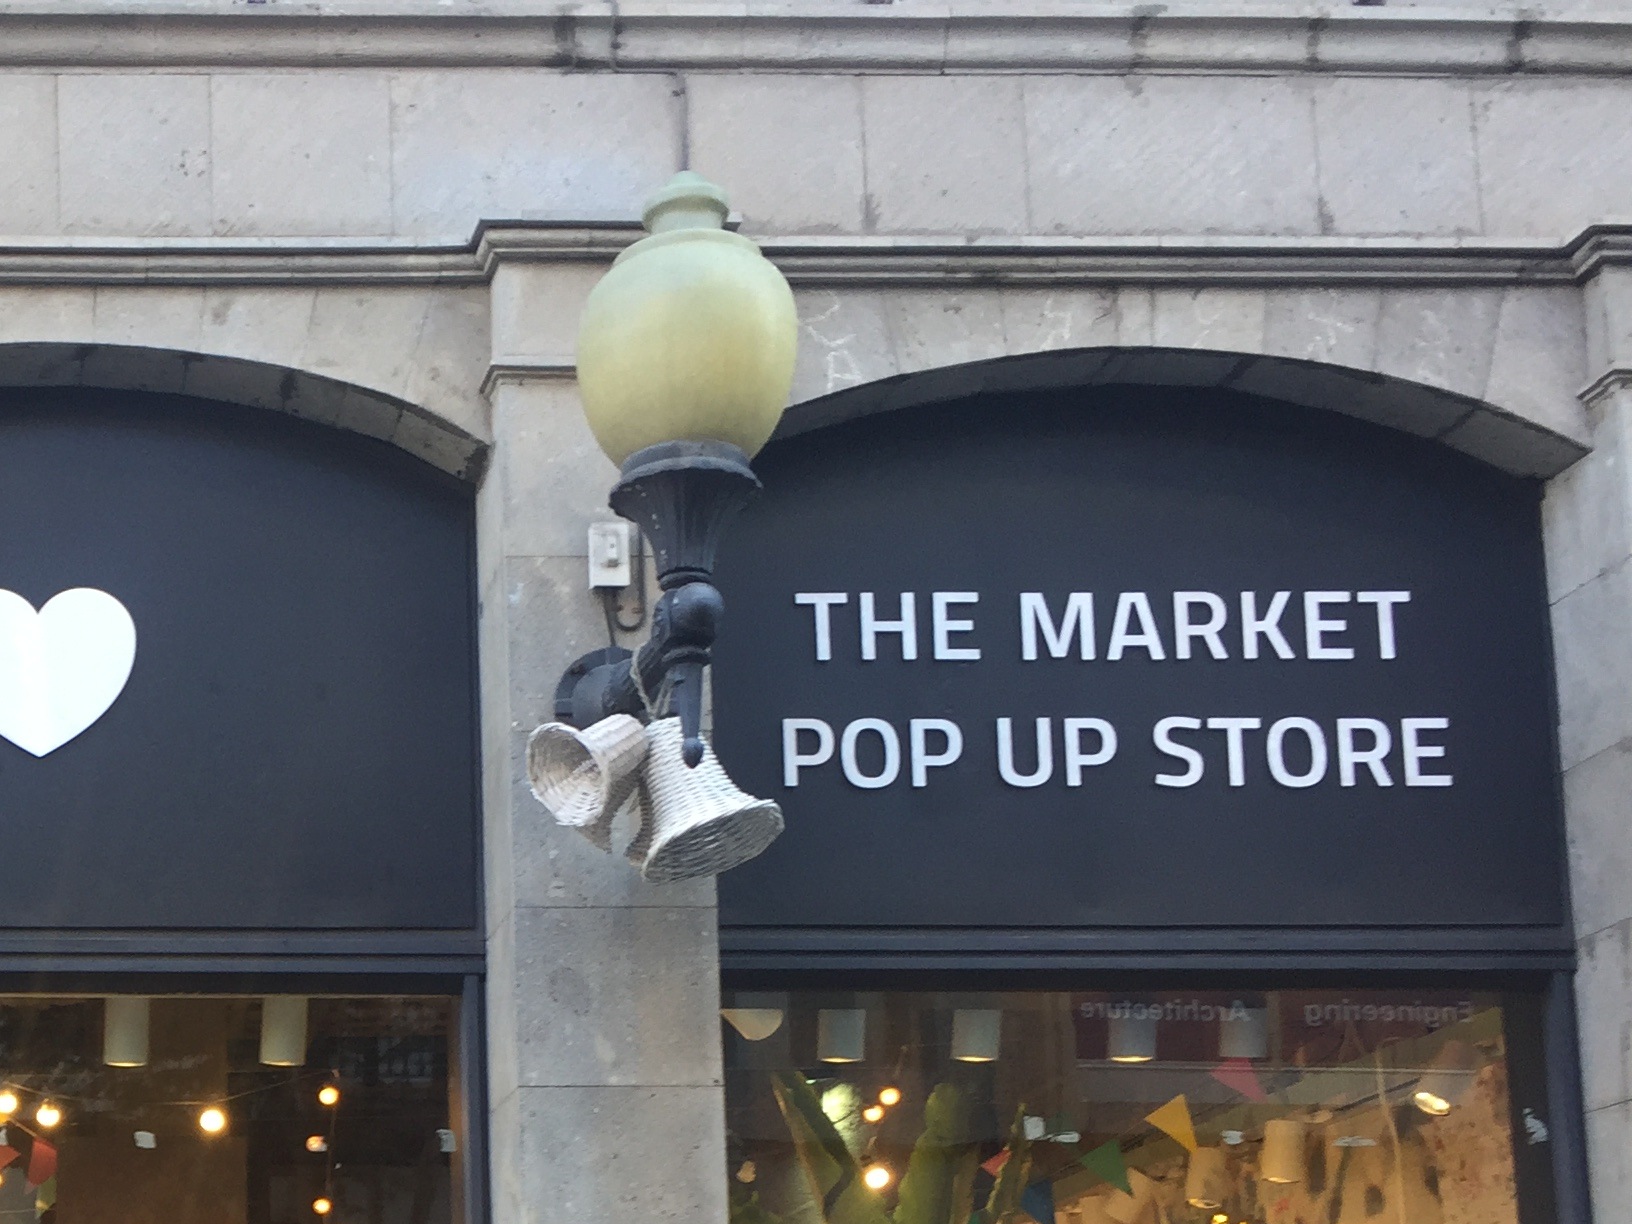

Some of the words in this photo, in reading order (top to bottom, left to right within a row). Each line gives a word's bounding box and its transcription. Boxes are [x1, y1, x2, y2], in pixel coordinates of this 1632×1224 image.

[794, 591, 981, 661] THE
[1019, 590, 1411, 661] MARKET
[782, 717, 963, 789] POP
[996, 717, 1118, 788] UP
[1153, 716, 1453, 788] STORE
